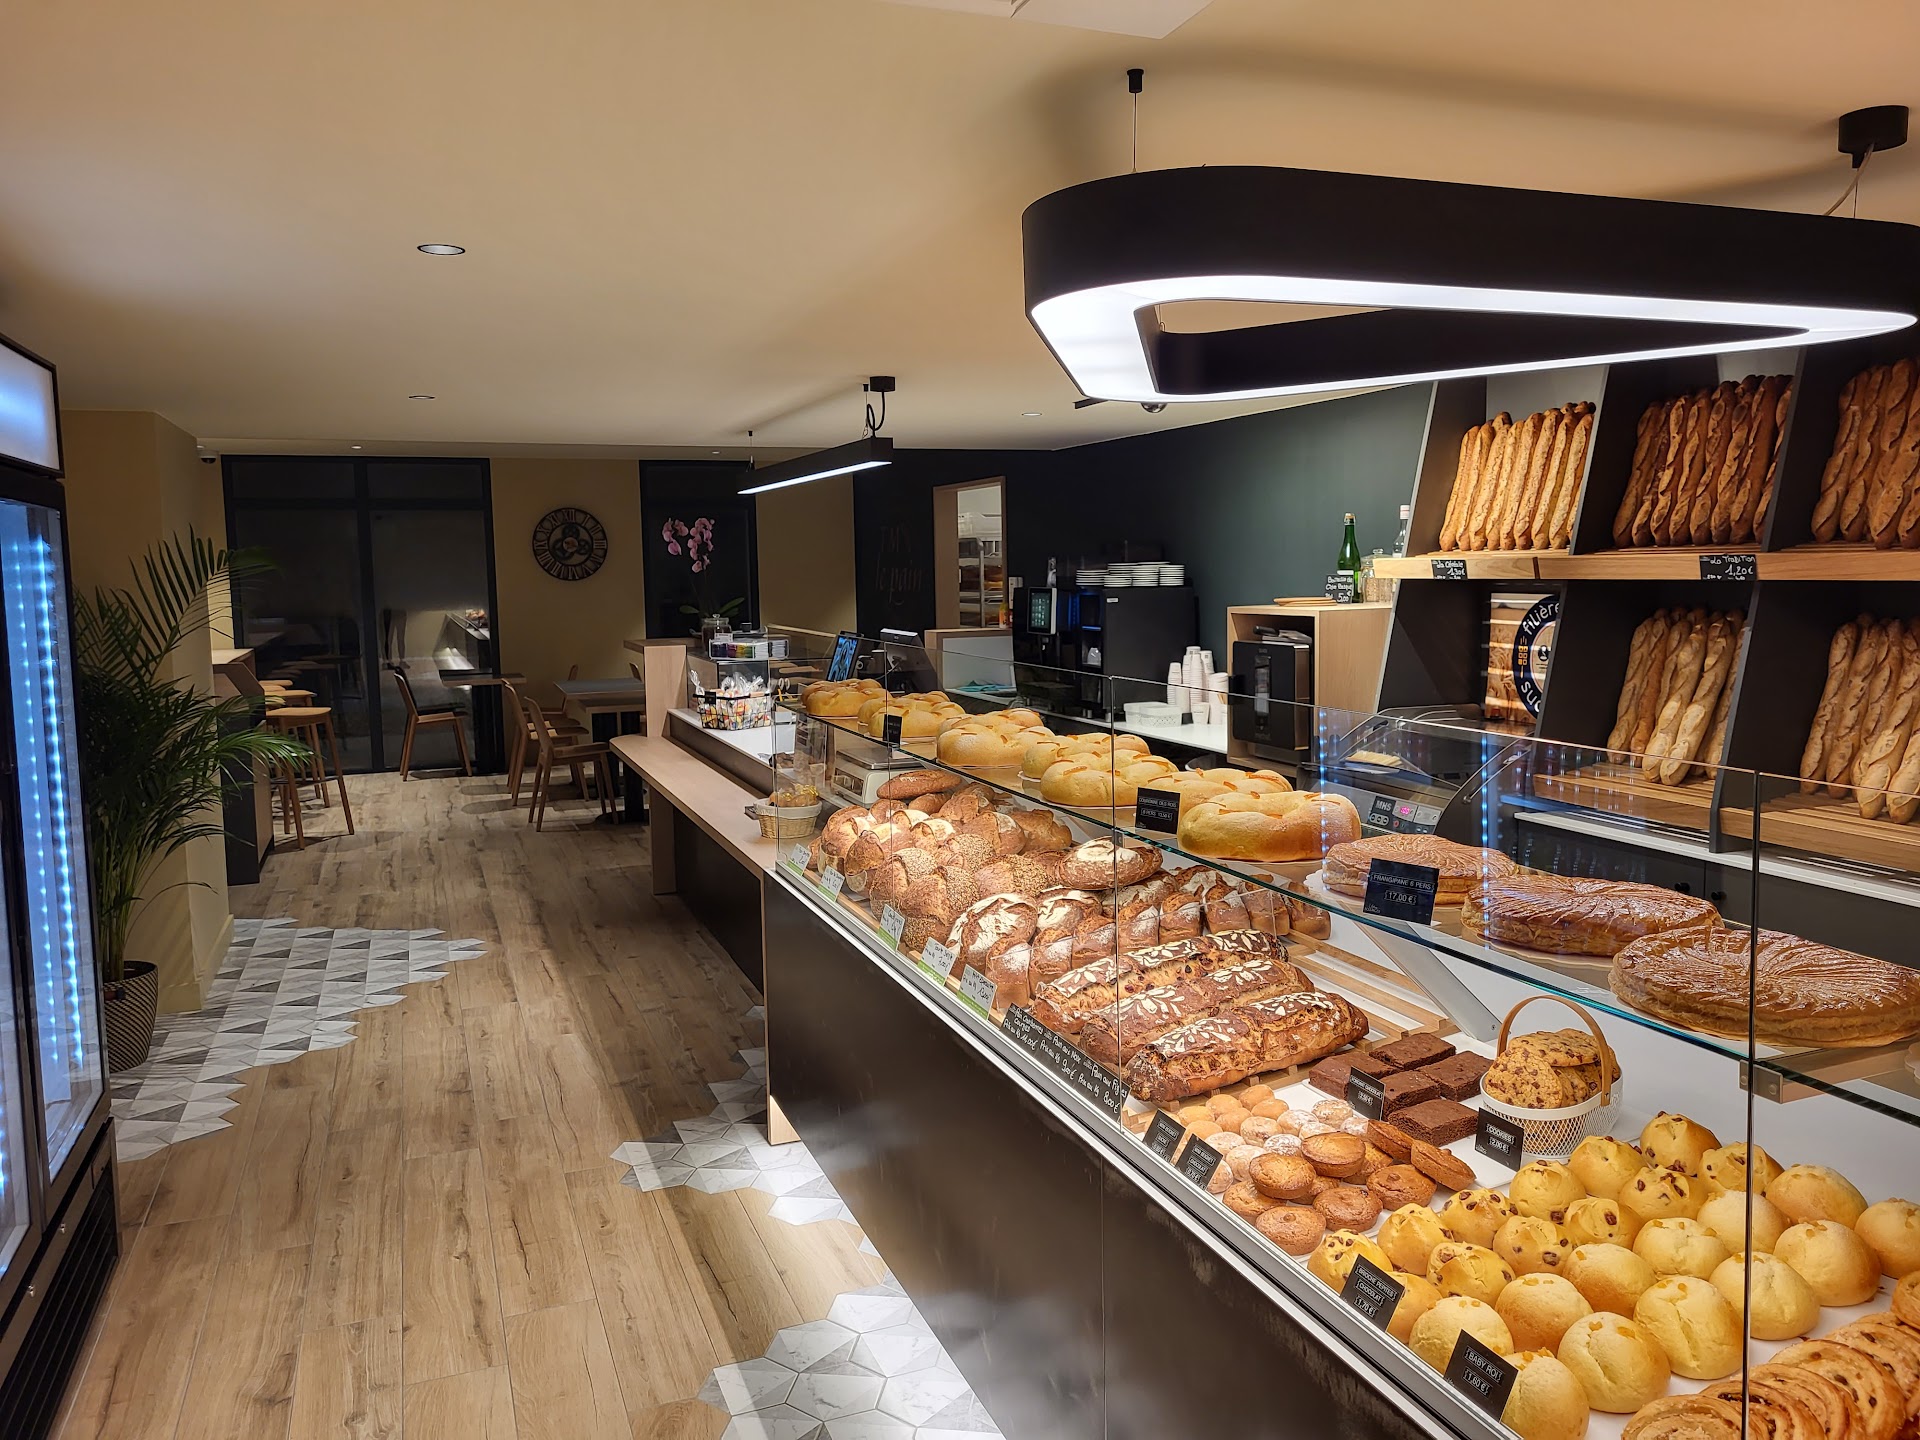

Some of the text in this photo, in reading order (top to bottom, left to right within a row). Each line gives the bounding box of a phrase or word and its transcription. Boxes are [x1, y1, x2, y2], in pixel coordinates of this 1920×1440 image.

[1373, 874, 1408, 886] FRANGIPANE
[1415, 882, 1431, 890] PERS
[1389, 892, 1407, 902] 17,00
[1489, 1126, 1512, 1142] COOKIES
[1358, 1267, 1377, 1284] BRIOCHE
[1359, 1282, 1382, 1302] CHOCOLAT
[1468, 1352, 1498, 1379] BABY ROI
